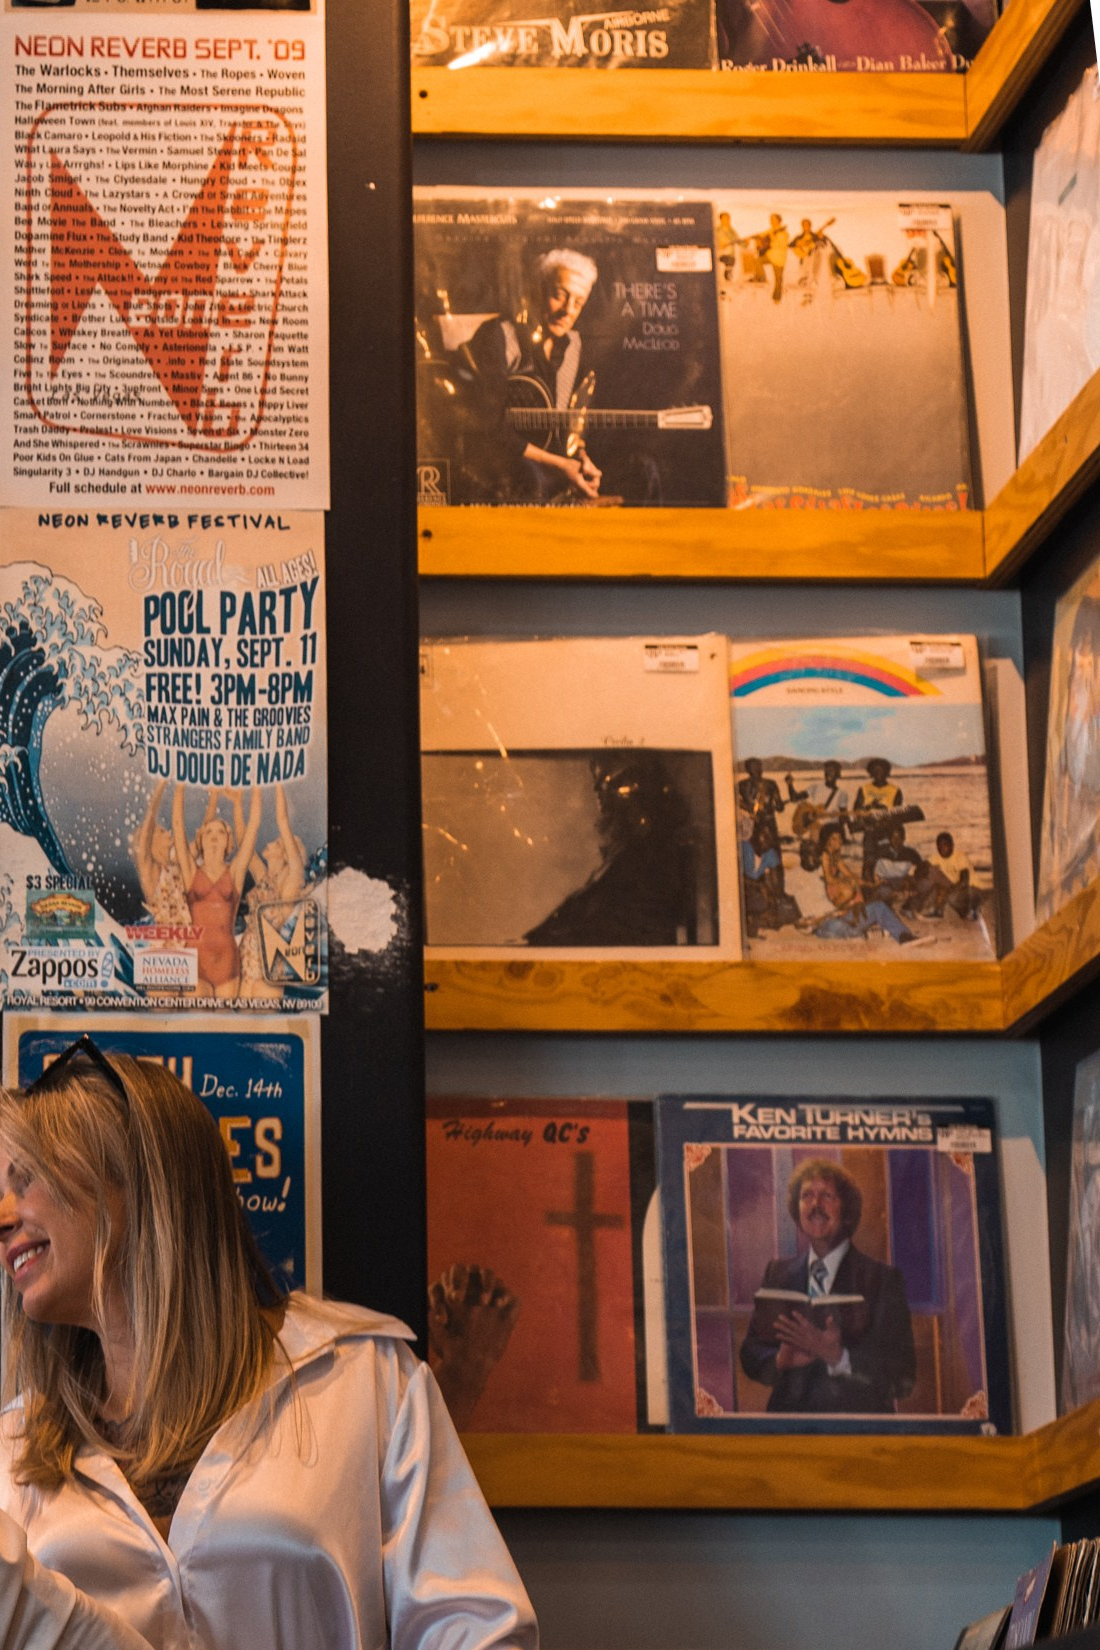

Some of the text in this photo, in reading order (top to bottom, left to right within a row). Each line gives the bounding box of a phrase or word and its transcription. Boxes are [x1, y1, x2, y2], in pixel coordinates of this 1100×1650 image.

[413, 16, 670, 59] STEVE MORIS
[15, 35, 305, 60] NEON REVERB SEPT. '09
[857, 56, 894, 71] Dian
[900, 53, 946, 71] Baker
[15, 64, 305, 80] The Warlocks Themselves The Ropes Woven
[15, 83, 305, 98] The Morning After Girls The Most Serene Republic
[615, 282, 678, 299] THERE'S
[621, 302, 677, 318] A TIME
[13, 453, 33, 461] Poor
[36, 453, 57, 461] Kids
[60, 453, 71, 461] On
[74, 453, 94, 461] Glue
[105, 453, 125, 462] Cats
[128, 454, 151, 462] From
[154, 454, 181, 464] Japan
[249, 455, 276, 464] Locke
[287, 455, 309, 465] Load
[13, 467, 63, 478] Singularity
[66, 467, 72, 476] 3
[83, 468, 95, 476] DJ
[98, 468, 140, 478] Handgun
[152, 468, 163, 477] DJ
[208, 469, 243, 479] Bargain
[246, 469, 259, 478] DJ
[49, 482, 275, 496] Full schedule at www.neonreverb.com
[39, 513, 290, 531] NEON REVERB FESTIVAL
[256, 549, 319, 589] ALL AGES!
[144, 576, 319, 637] POOL PARTY
[143, 632, 317, 670] SUNDAY, SEPT. 11
[146, 670, 313, 706] FREE! 3PM-8PM
[147, 705, 311, 727] MAX PAIN & THE GROOVIES
[147, 724, 311, 750] STRANGERS FAMILY BAND
[147, 746, 305, 787] DJ DOUG DE NADA
[45, 875, 93, 890] SPECIAL
[126, 925, 204, 940] WEEKLY
[28, 949, 100, 957] PRESENTED BY
[142, 957, 188, 967] NEVADA
[11, 950, 99, 986] Zappos
[142, 967, 189, 975] HOMELESS
[6, 996, 40, 1006] ROYAL
[41, 996, 78, 1006] RESORT
[97, 997, 156, 1007] CONVENTION
[158, 998, 196, 1008] CENTER
[197, 998, 225, 1008] DRIVE
[230, 998, 248, 1009] LAS
[282, 999, 295, 1009] NV
[200, 1074, 283, 1099] Dec. 14th
[731, 1103, 796, 1125] KEN
[442, 1120, 533, 1147] Highway
[733, 1125, 840, 1140] FAVORITE
[847, 1126, 934, 1142] HYMNS
